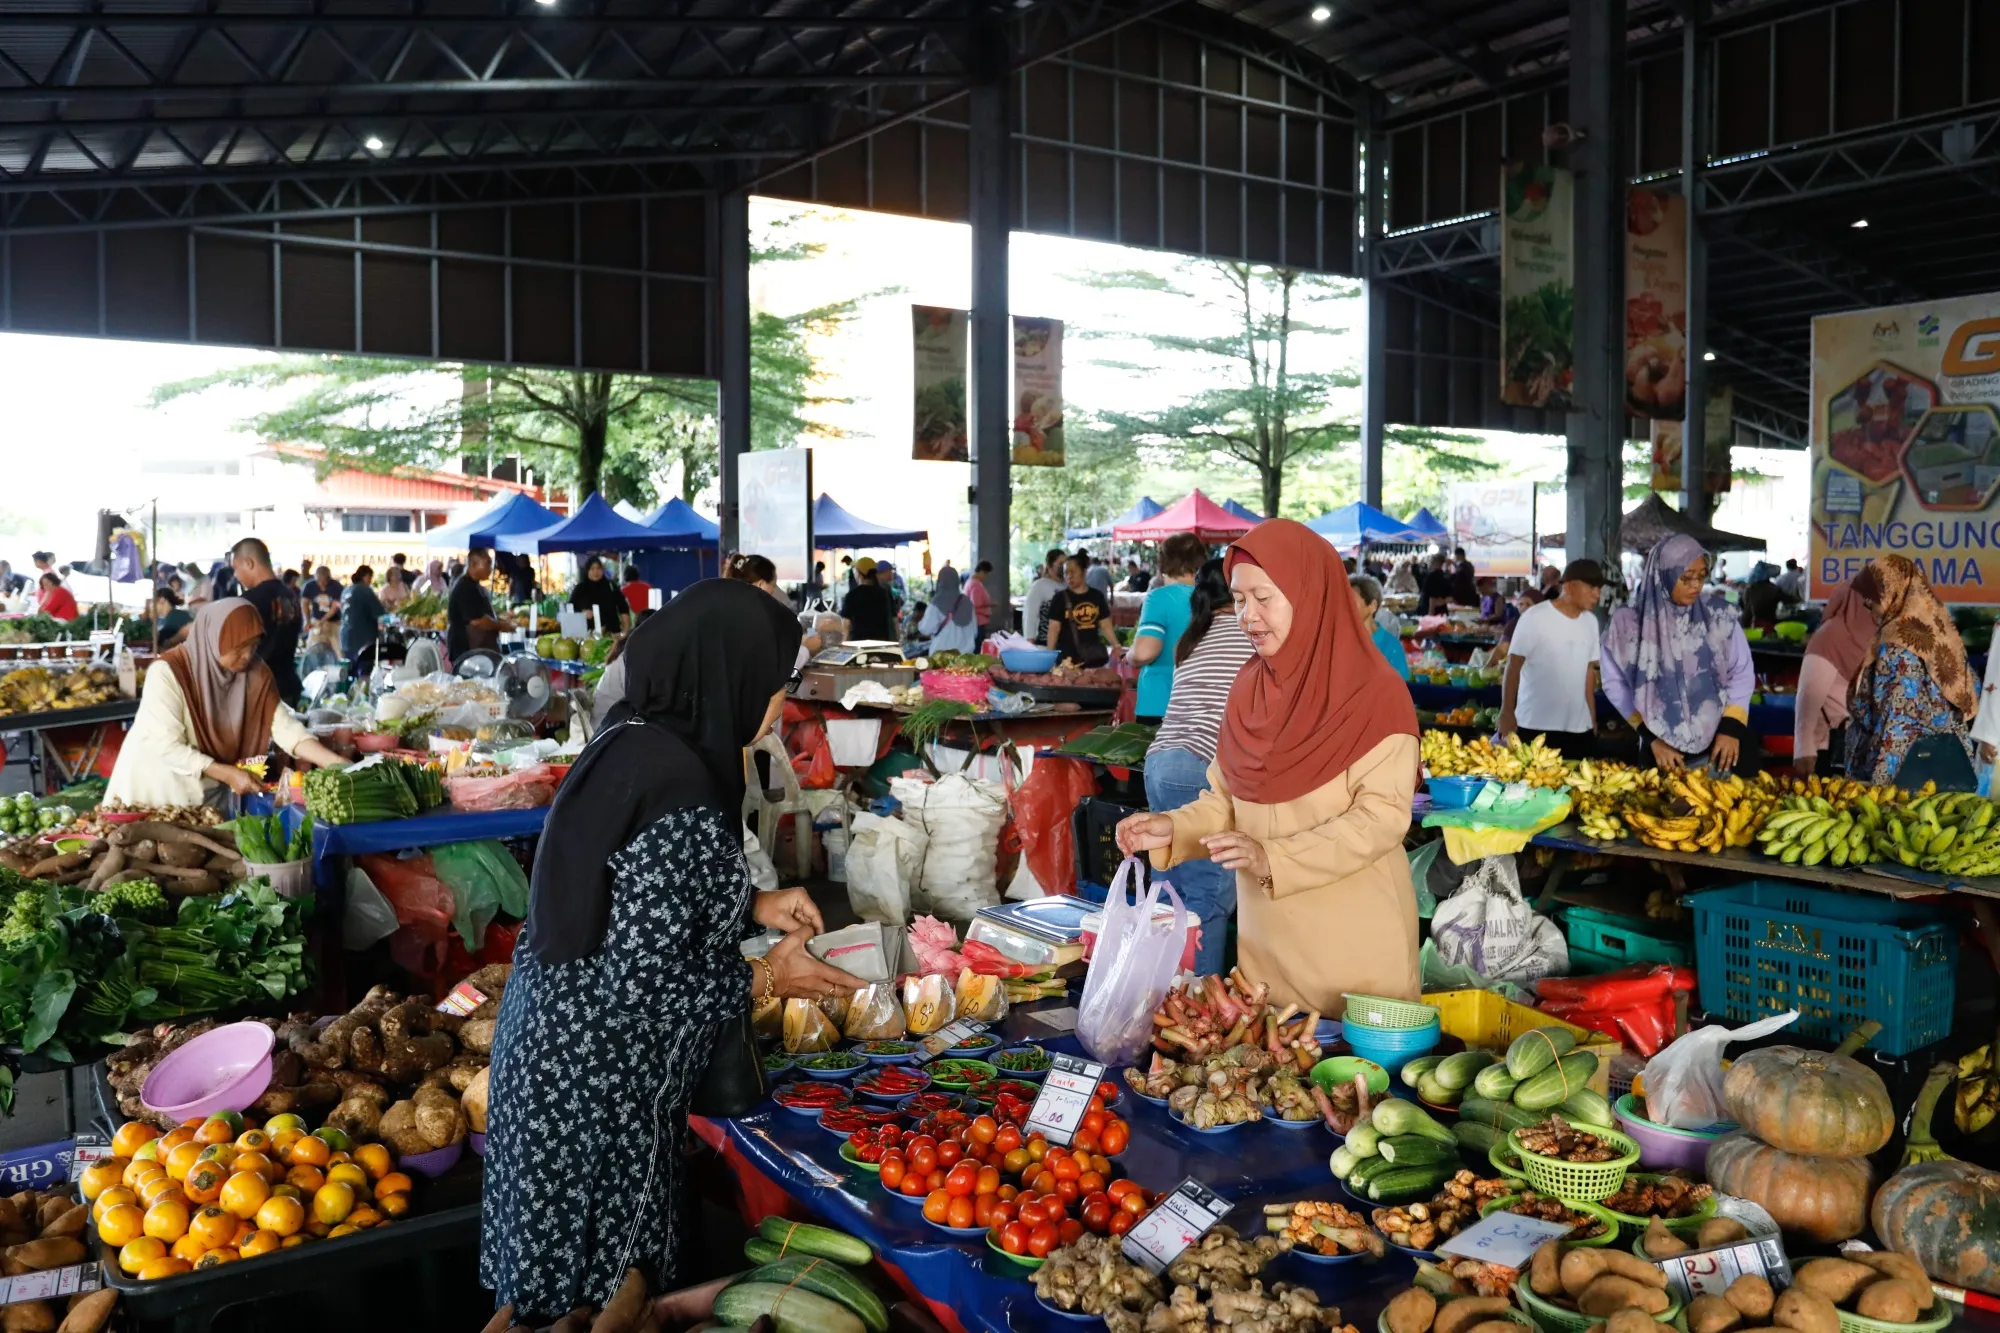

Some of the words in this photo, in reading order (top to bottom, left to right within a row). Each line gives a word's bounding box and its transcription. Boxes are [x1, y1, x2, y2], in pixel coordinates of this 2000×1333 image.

[906, 1001, 936, 1031] 1.80
[1031, 1098, 1064, 1123] 2.00
[1135, 1217, 1167, 1253] 5.00
